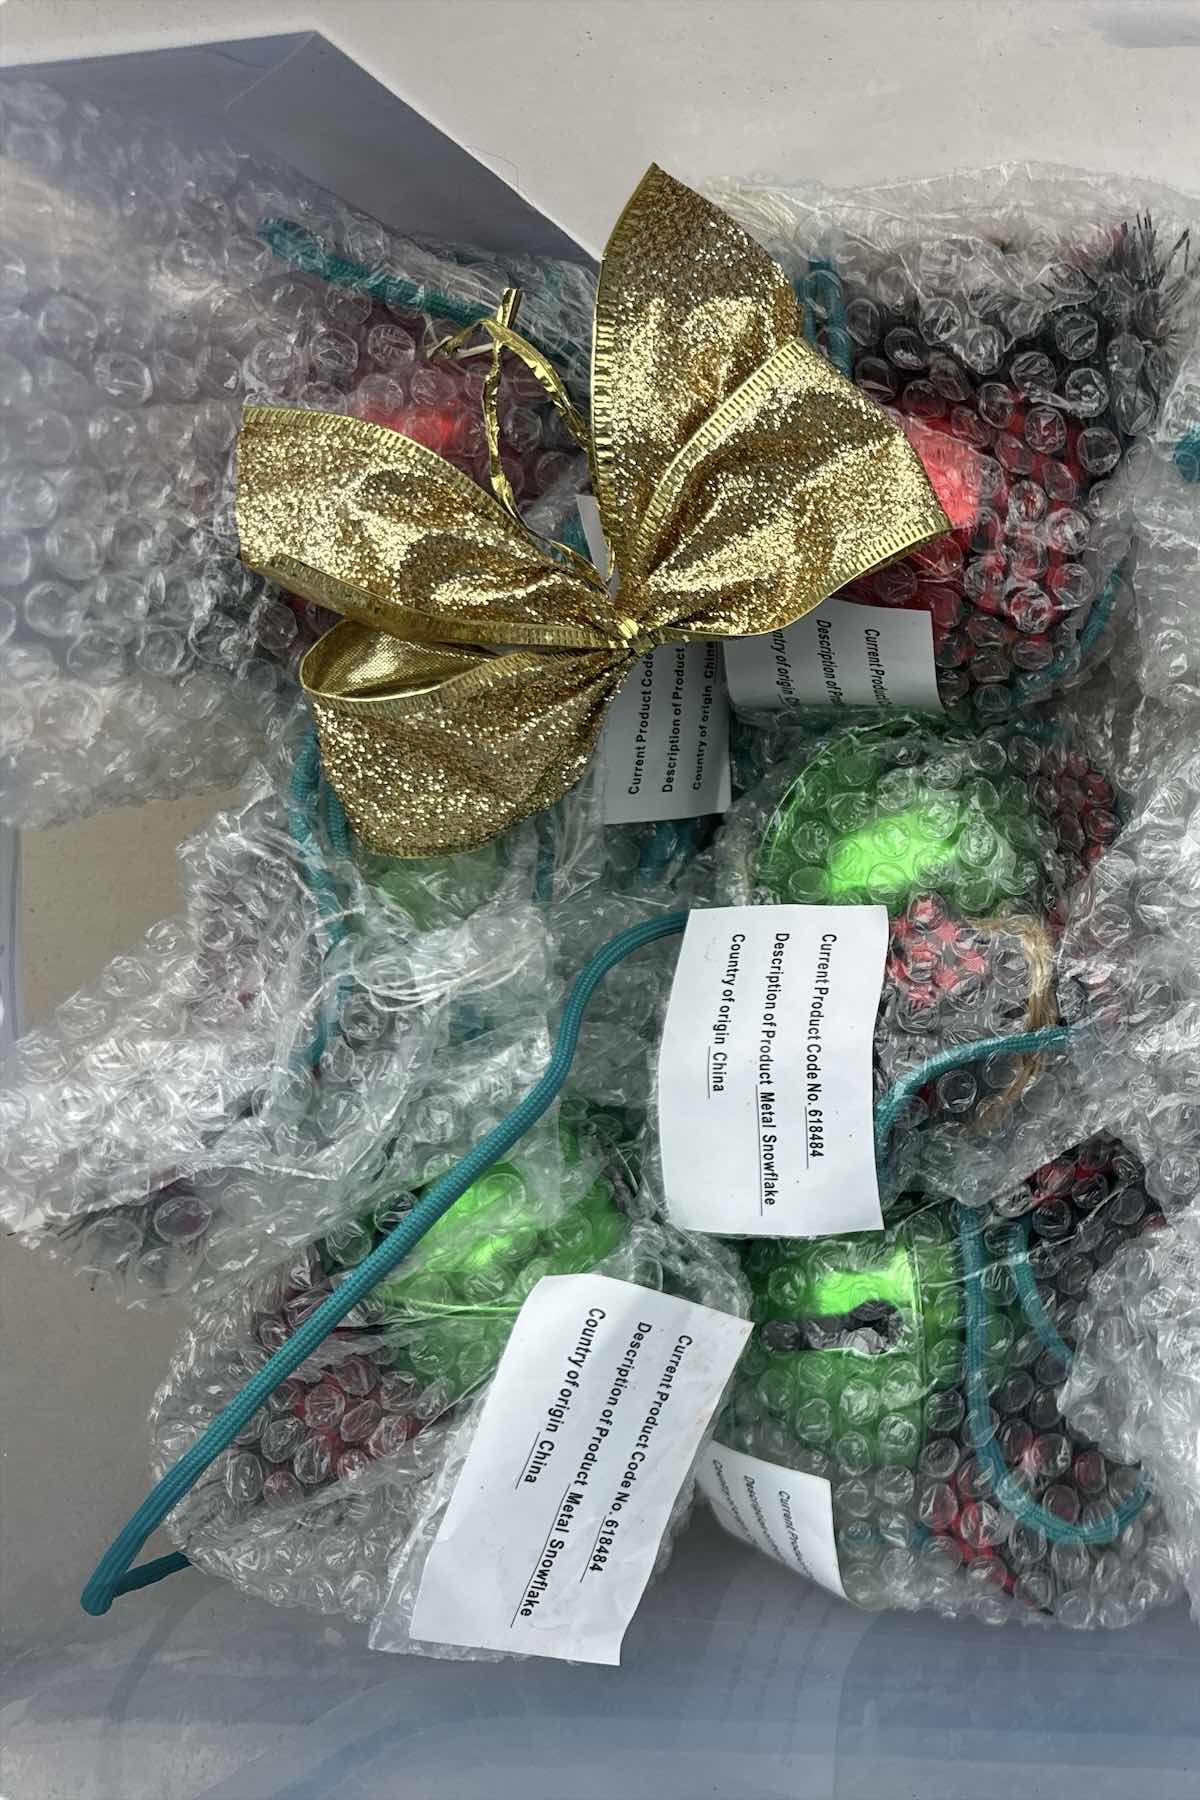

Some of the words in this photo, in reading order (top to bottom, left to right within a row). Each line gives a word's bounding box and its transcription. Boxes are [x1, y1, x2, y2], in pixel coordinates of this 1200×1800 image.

[776, 655, 791, 667] of
[816, 620, 840, 678] Description
[864, 629, 883, 666] Current
[641, 654, 653, 687] Code
[672, 648, 685, 700] Product
[776, 668, 795, 694] origin
[825, 681, 841, 690] of
[636, 691, 652, 742] Product
[672, 703, 682, 715] of
[701, 686, 713, 721] origin
[697, 725, 708, 737] of
[628, 746, 646, 794] Current
[662, 720, 681, 792] Description
[692, 741, 707, 790] Country
[722, 934, 745, 986] Country
[765, 933, 789, 1009] Description
[816, 934, 836, 984] Current
[721, 990, 735, 1002] of
[808, 987, 828, 1040] Product
[713, 1006, 730, 1044] origin
[762, 1014, 776, 1027] of
[712, 1052, 727, 1092] China
[759, 1030, 775, 1085] Product
[807, 1044, 821, 1079] Code
[760, 1092, 775, 1128] Metal
[807, 1083, 821, 1105] No.
[808, 1109, 824, 1157] 618484
[762, 1134, 777, 1205] Snowflake
[569, 1308, 606, 1368] Country
[566, 1370, 581, 1387] of
[607, 1322, 652, 1406] Description
[658, 1335, 693, 1389] Current
[544, 1388, 572, 1432] origin
[597, 1409, 615, 1427] of
[635, 1391, 671, 1448] Product
[525, 1440, 554, 1483] China
[574, 1427, 607, 1486] Product
[621, 1451, 646, 1488] Code
[555, 1492, 580, 1533] Metal
[609, 1492, 631, 1515] No.
[589, 1519, 619, 1572] 618484
[520, 1539, 564, 1617] Snowflake
